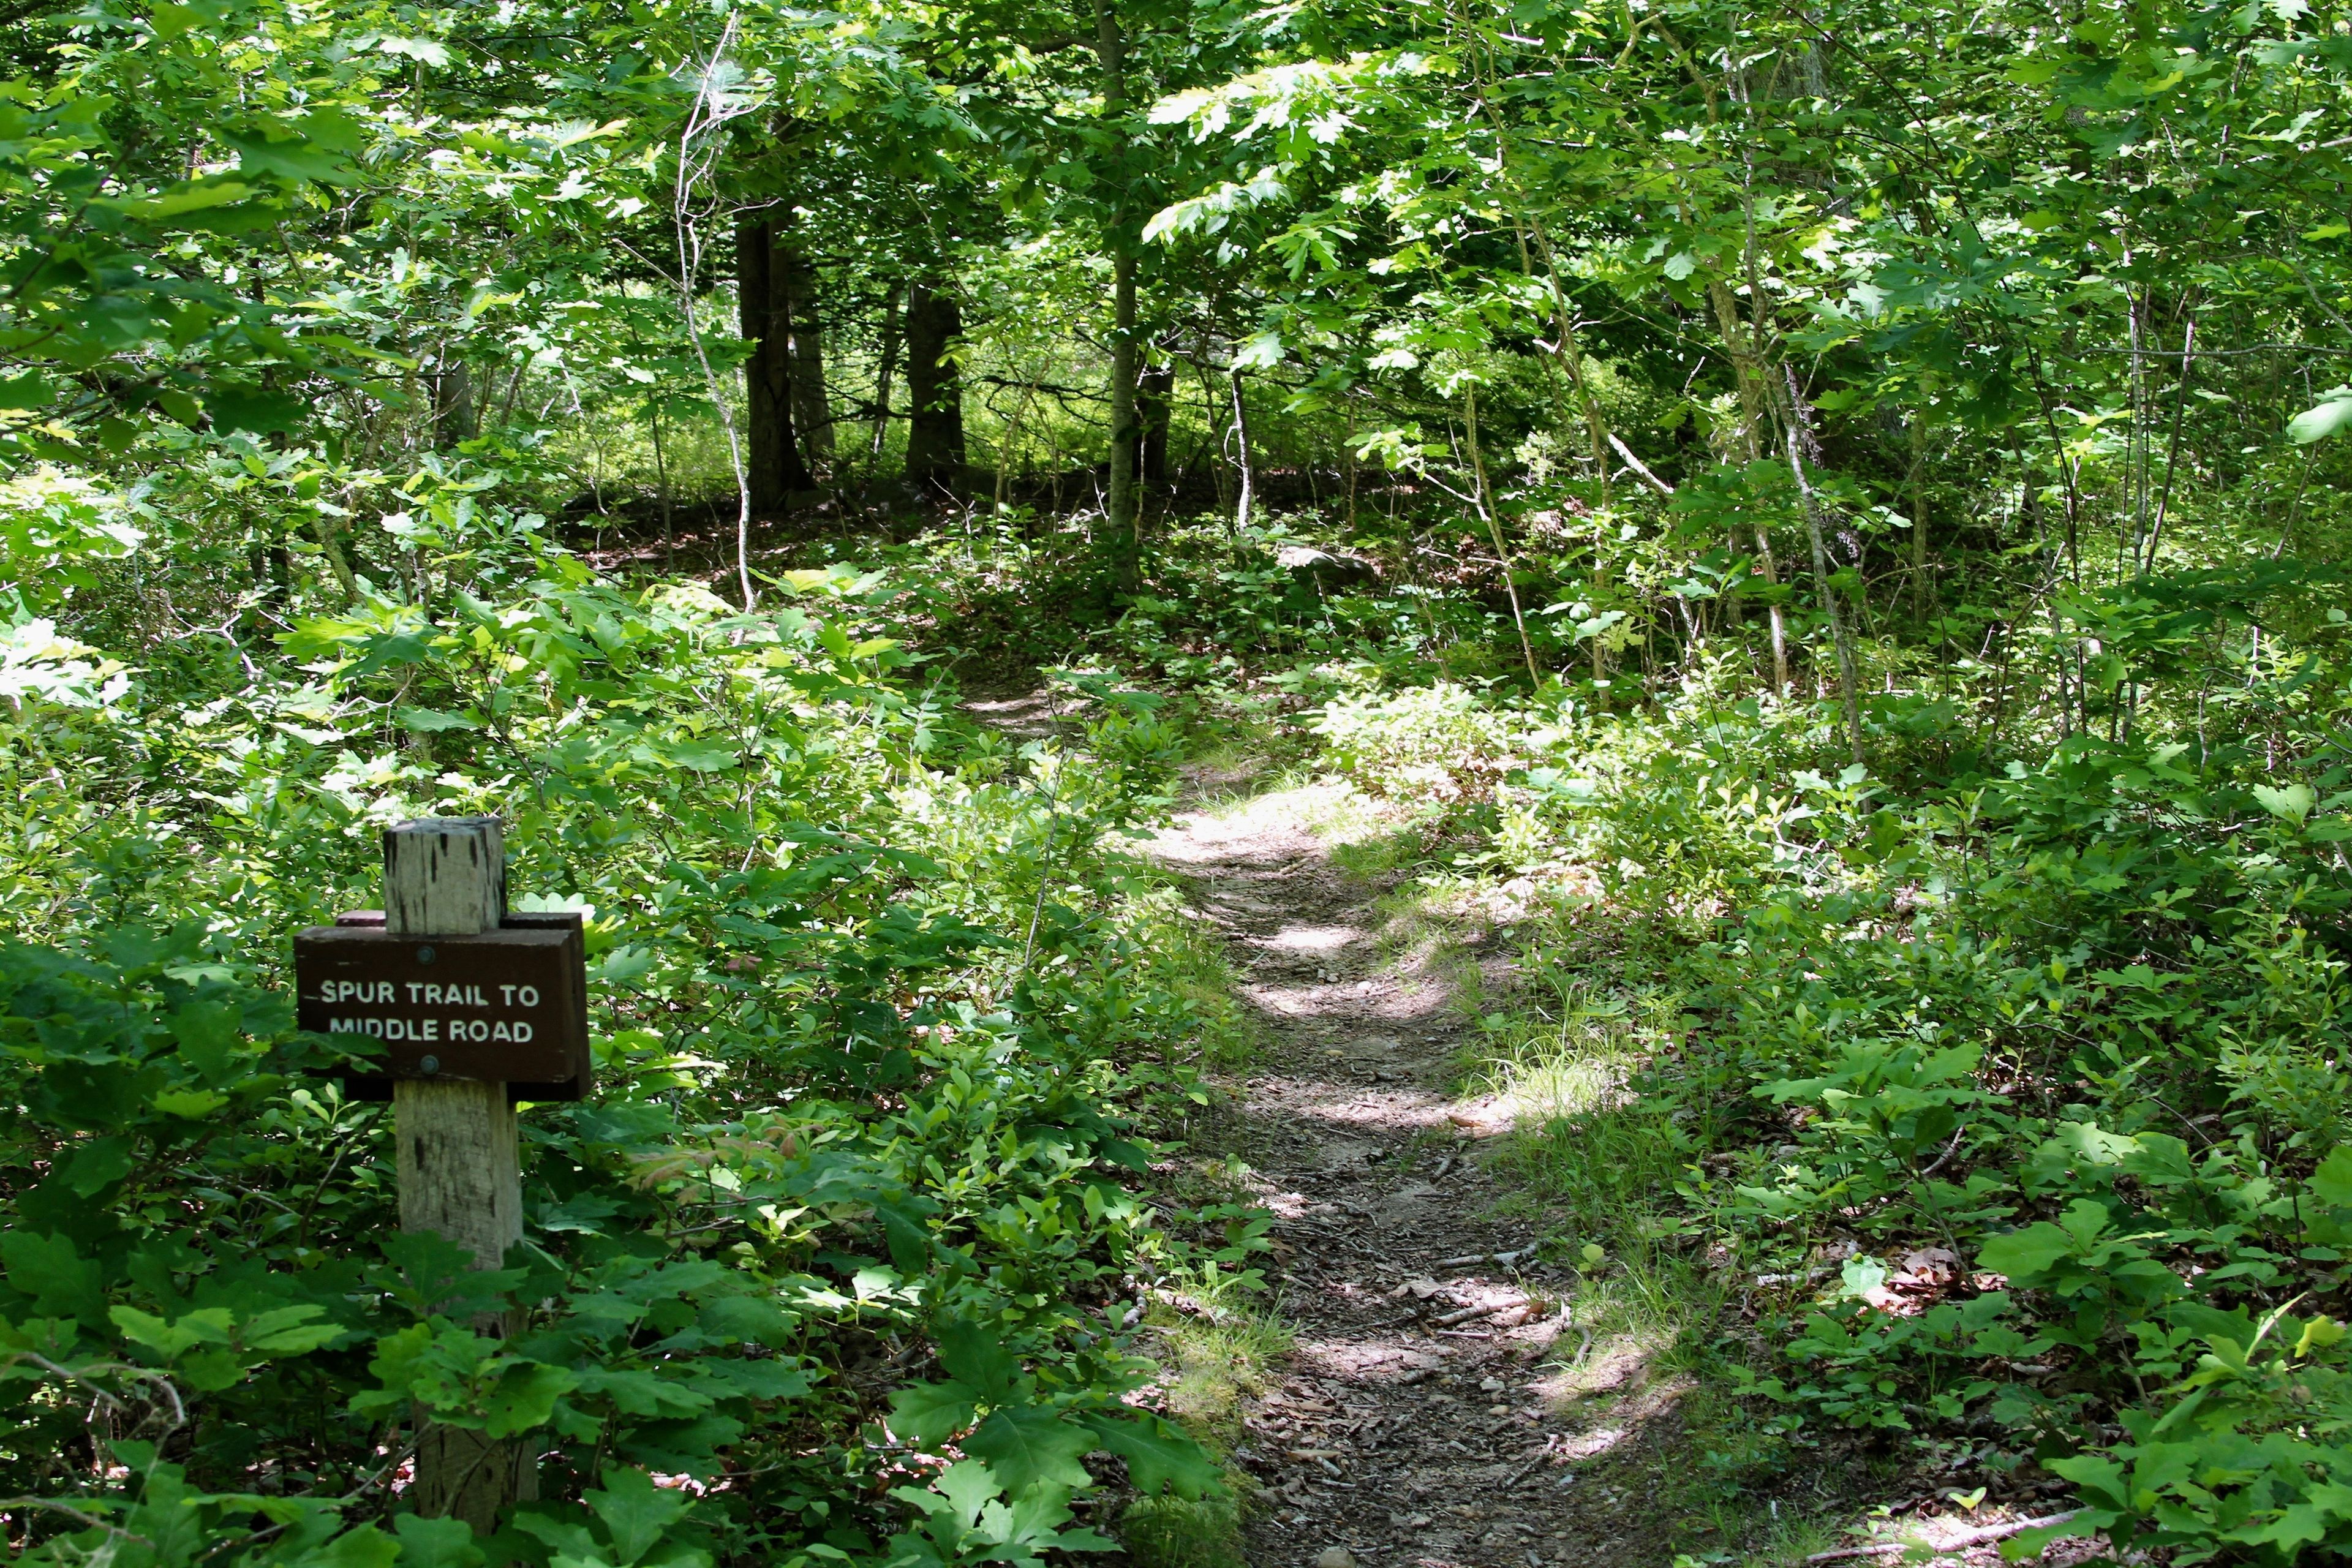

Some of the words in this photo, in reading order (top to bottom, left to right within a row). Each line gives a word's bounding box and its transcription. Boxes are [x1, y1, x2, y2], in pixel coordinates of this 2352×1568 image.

[321, 980, 395, 1003] SPUR
[405, 982, 489, 1006] TRAIL
[499, 984, 540, 1007] TO
[330, 1017, 439, 1041] MIDDLE
[449, 1020, 533, 1042] ROAD
